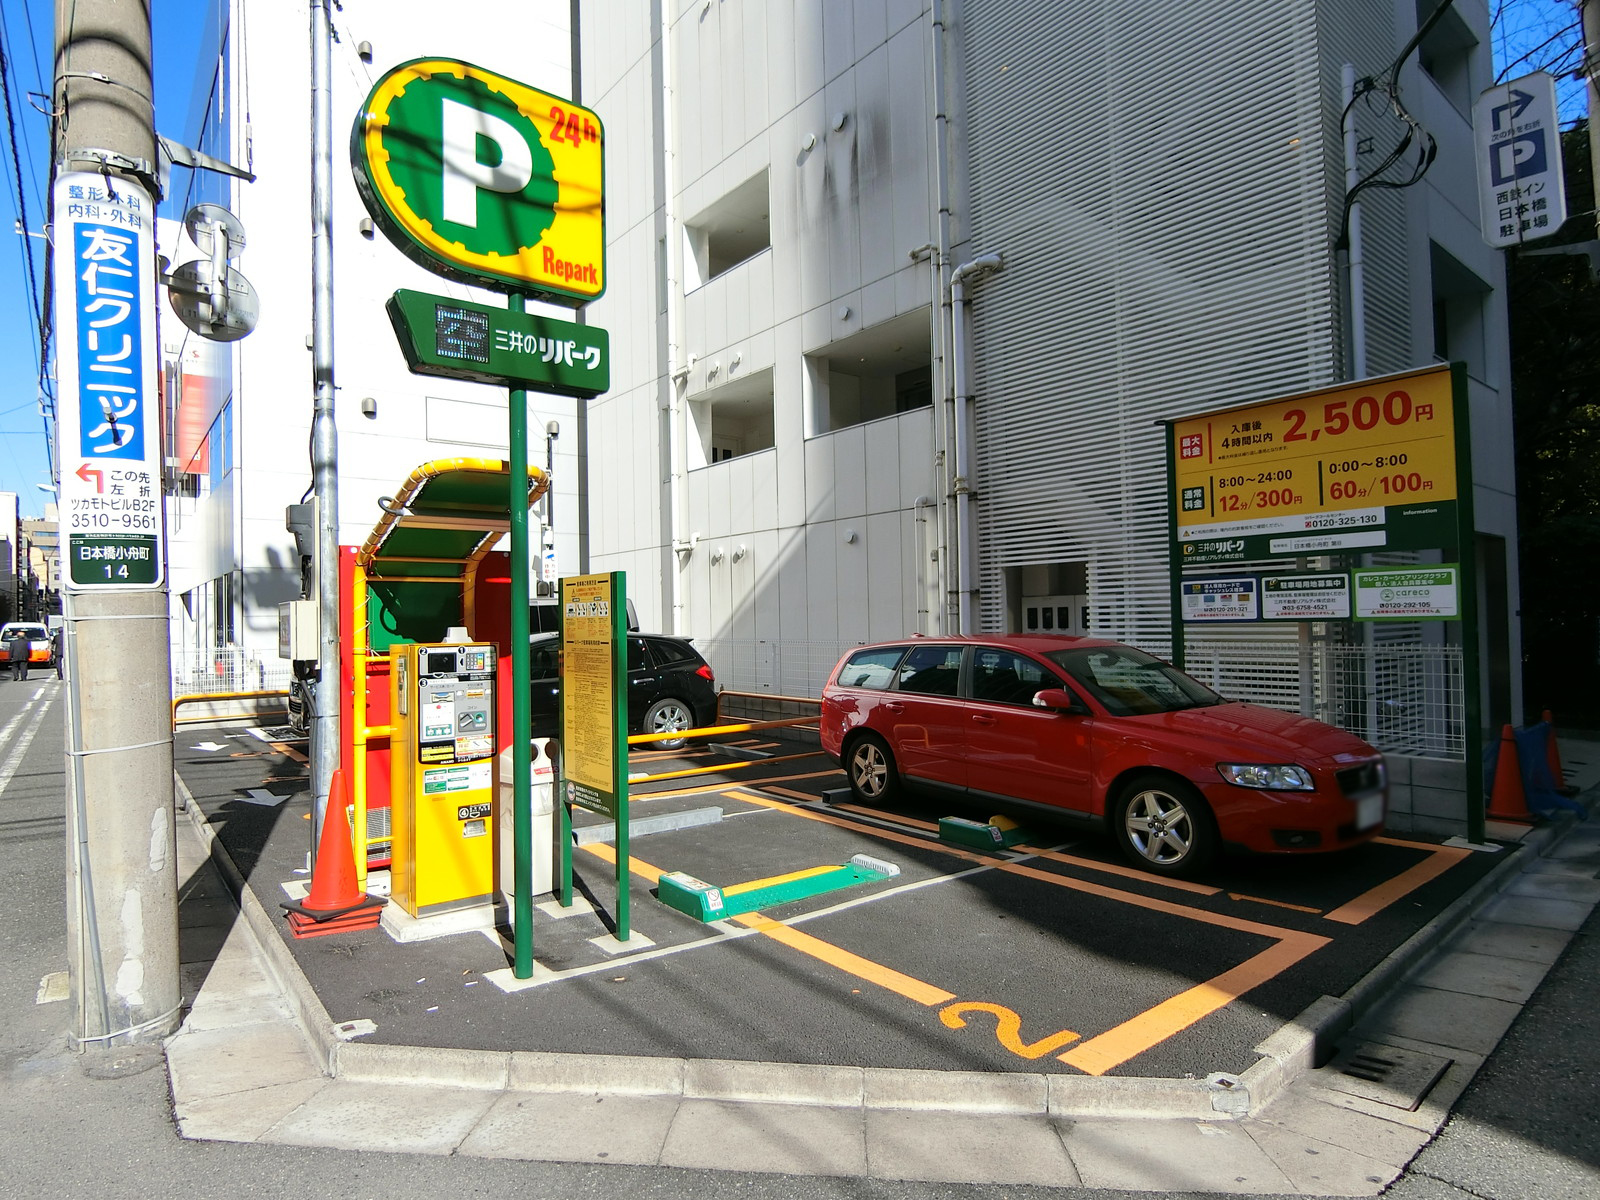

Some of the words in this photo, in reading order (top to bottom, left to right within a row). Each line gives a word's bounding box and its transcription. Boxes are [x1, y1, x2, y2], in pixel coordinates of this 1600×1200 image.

[549, 106, 597, 148] 24h
[442, 97, 533, 228] P
[1499, 139, 1536, 179] P
[68, 184, 141, 211] 整形外科
[1496, 182, 1545, 205] 西鉄イン
[68, 203, 142, 230] 内科・外科
[1499, 197, 1547, 221] 日本橋
[1500, 214, 1549, 238] 駐車場
[542, 246, 598, 285] Repark
[81, 228, 138, 454] 友仁クリニック
[495, 328, 601, 371] 三井のリパーク
[1283, 390, 1434, 443] 2,500円
[1231, 420, 1262, 435] 入庫後
[1182, 436, 1201, 447] 最大
[1221, 432, 1273, 449] 4時間以内
[1183, 447, 1201, 457] 料金
[111, 470, 151, 484] この先
[1184, 488, 1203, 499] 通常
[71, 498, 156, 512] ツカモトビルB2F
[1184, 499, 1203, 509] 料金
[1402, 507, 1438, 516] information
[71, 513, 156, 529] 3510-9561
[1312, 514, 1378, 529] 0120-325-130
[80, 546, 150, 561] 日本橋小舟町
[1198, 540, 1245, 553] 三井のリパーク
[105, 564, 129, 579] 14
[1396, 589, 1430, 597] careco
[939, 1001, 1082, 1060] 2
